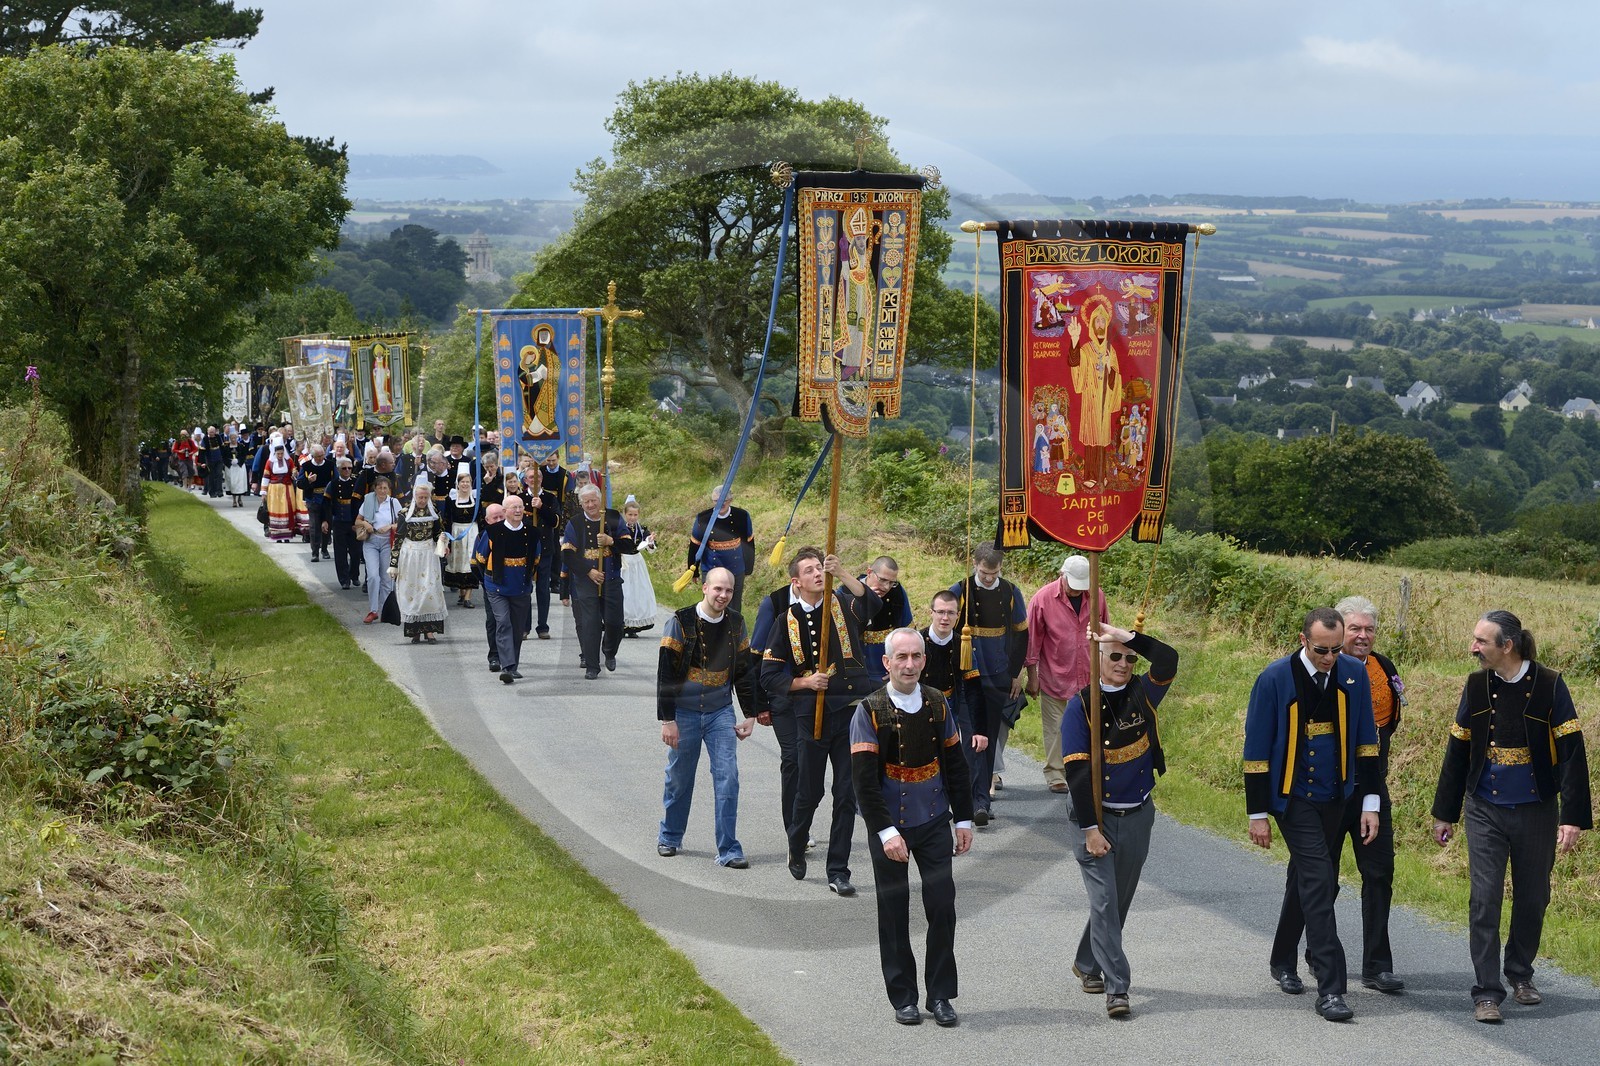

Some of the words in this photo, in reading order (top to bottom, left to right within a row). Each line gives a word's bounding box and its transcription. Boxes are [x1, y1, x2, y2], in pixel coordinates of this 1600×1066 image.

[873, 191, 904, 203] LOKORN
[1027, 245, 1090, 262] PARREZ
[1097, 244, 1160, 262] LOKORN
[1061, 497, 1096, 510] SANT
